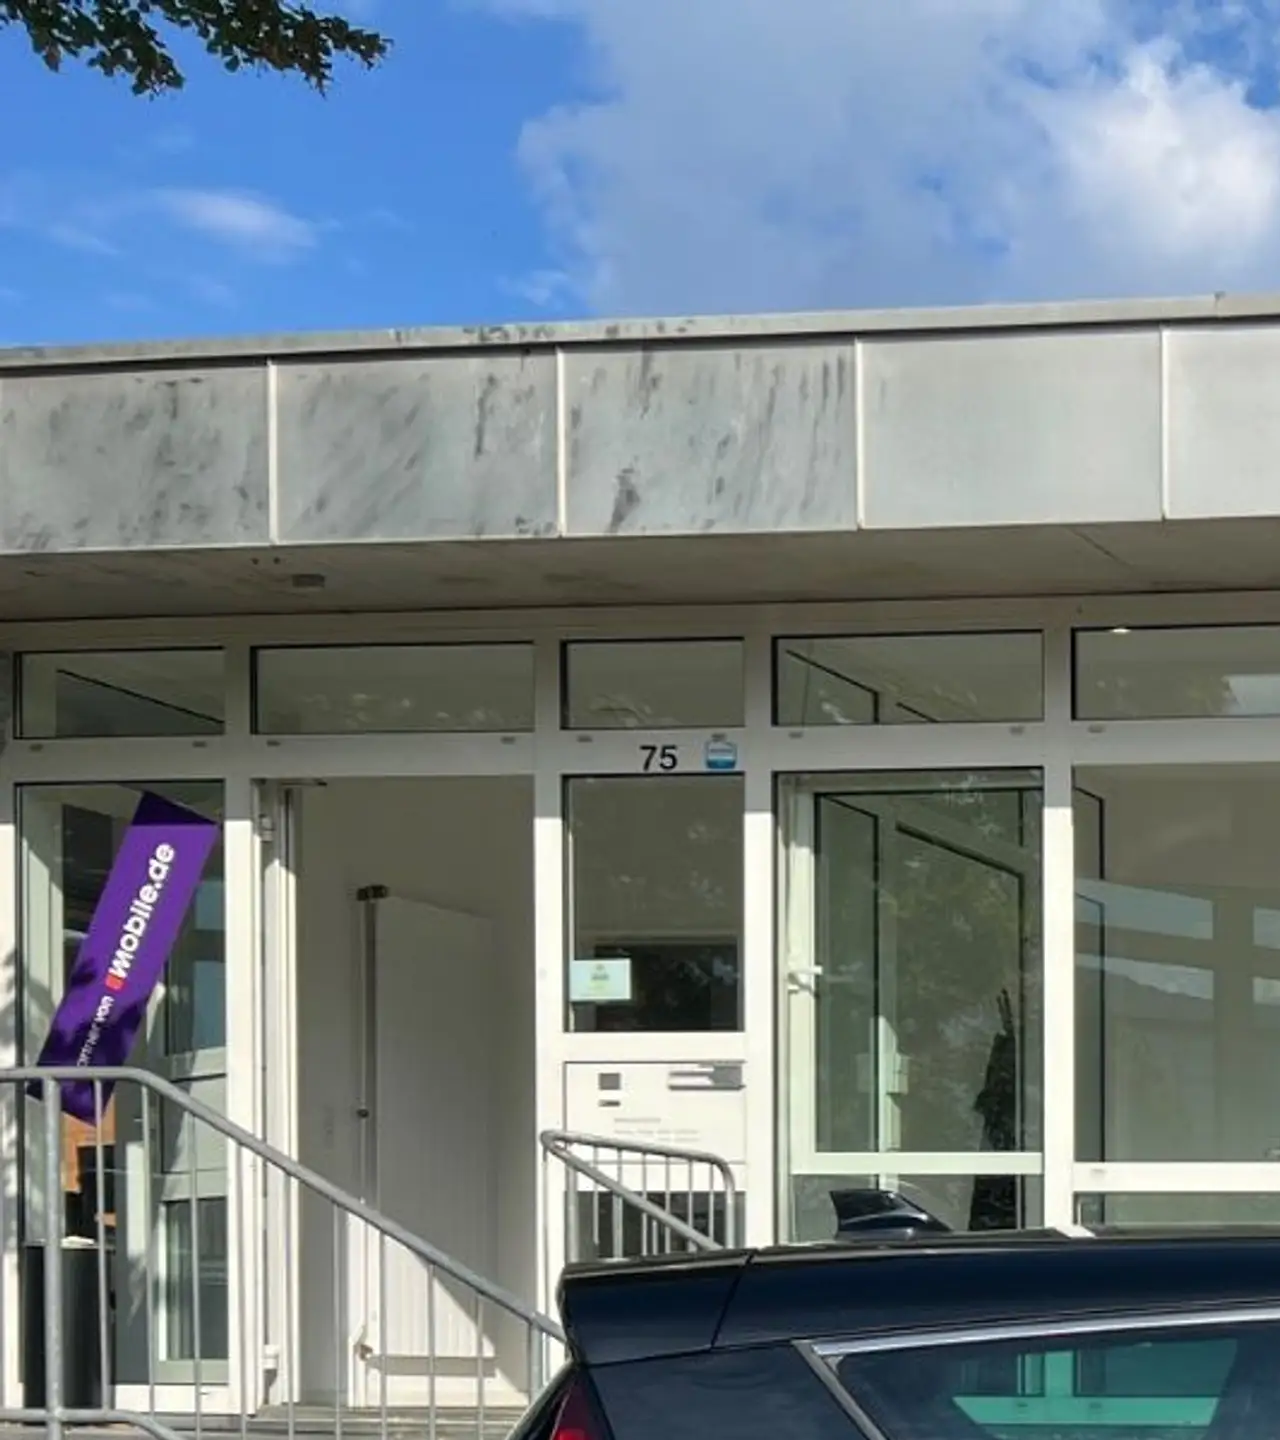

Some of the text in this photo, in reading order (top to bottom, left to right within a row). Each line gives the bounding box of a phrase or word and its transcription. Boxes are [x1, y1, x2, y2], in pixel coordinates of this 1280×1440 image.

[639, 745, 679, 772] 75
[94, 995, 116, 1024] von
[108, 842, 176, 979] mobile.de
